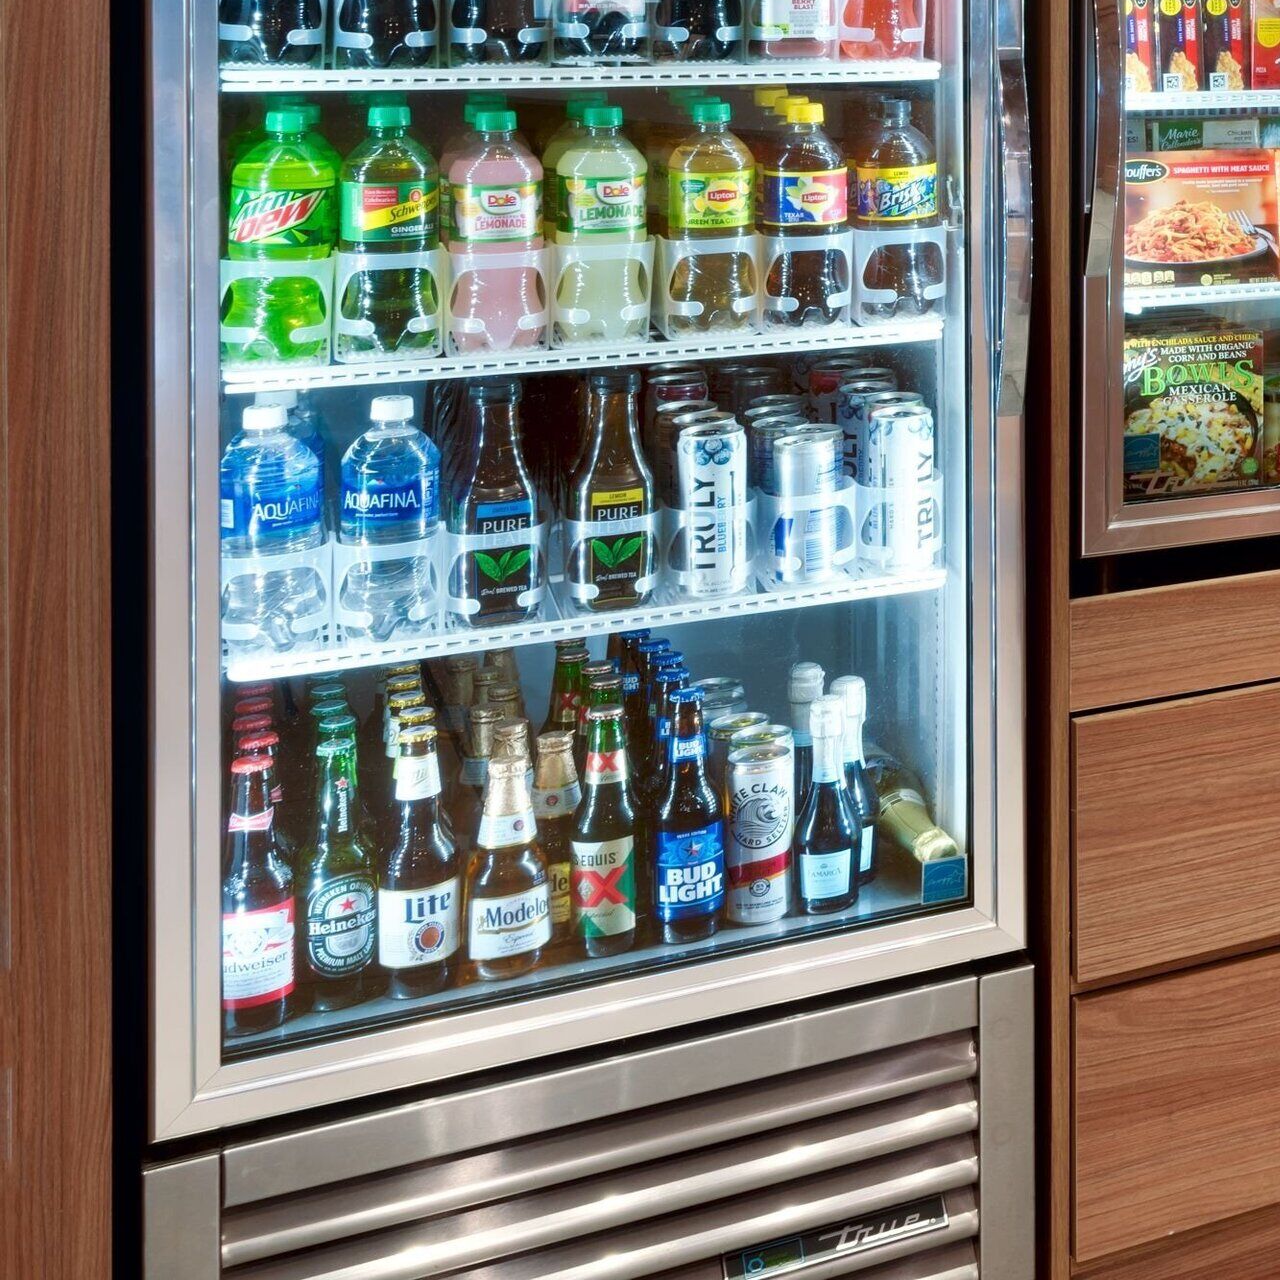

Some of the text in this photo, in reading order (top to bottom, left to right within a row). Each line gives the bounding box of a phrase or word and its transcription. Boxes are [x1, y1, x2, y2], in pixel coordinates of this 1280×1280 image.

[603, 185, 630, 198] Dole
[707, 190, 737, 202] Lipton
[802, 192, 829, 203] Lipton
[878, 179, 924, 212] Brisk
[487, 194, 516, 208] Dole
[578, 202, 644, 220] LEMONADE
[391, 224, 417, 234] GINGER
[474, 218, 528, 231] LEMONADE
[1160, 342, 1255, 356] MADE WITH ORGANIC
[1168, 351, 1247, 363] CORN AND BEANS
[1140, 360, 1254, 397] BOWLS
[1169, 384, 1232, 396] MEXICAN
[1163, 392, 1238, 407] CASSEROLE
[343, 489, 420, 511] AQUAFINA
[597, 505, 639, 521] PURE
[482, 517, 528, 535] PURE
[695, 477, 716, 570] TRULY
[736, 831, 761, 846] HARD
[666, 861, 717, 886] BUD
[659, 875, 723, 904] LIGHT
[404, 891, 451, 926] Lite
[819, 1213, 930, 1252] true
